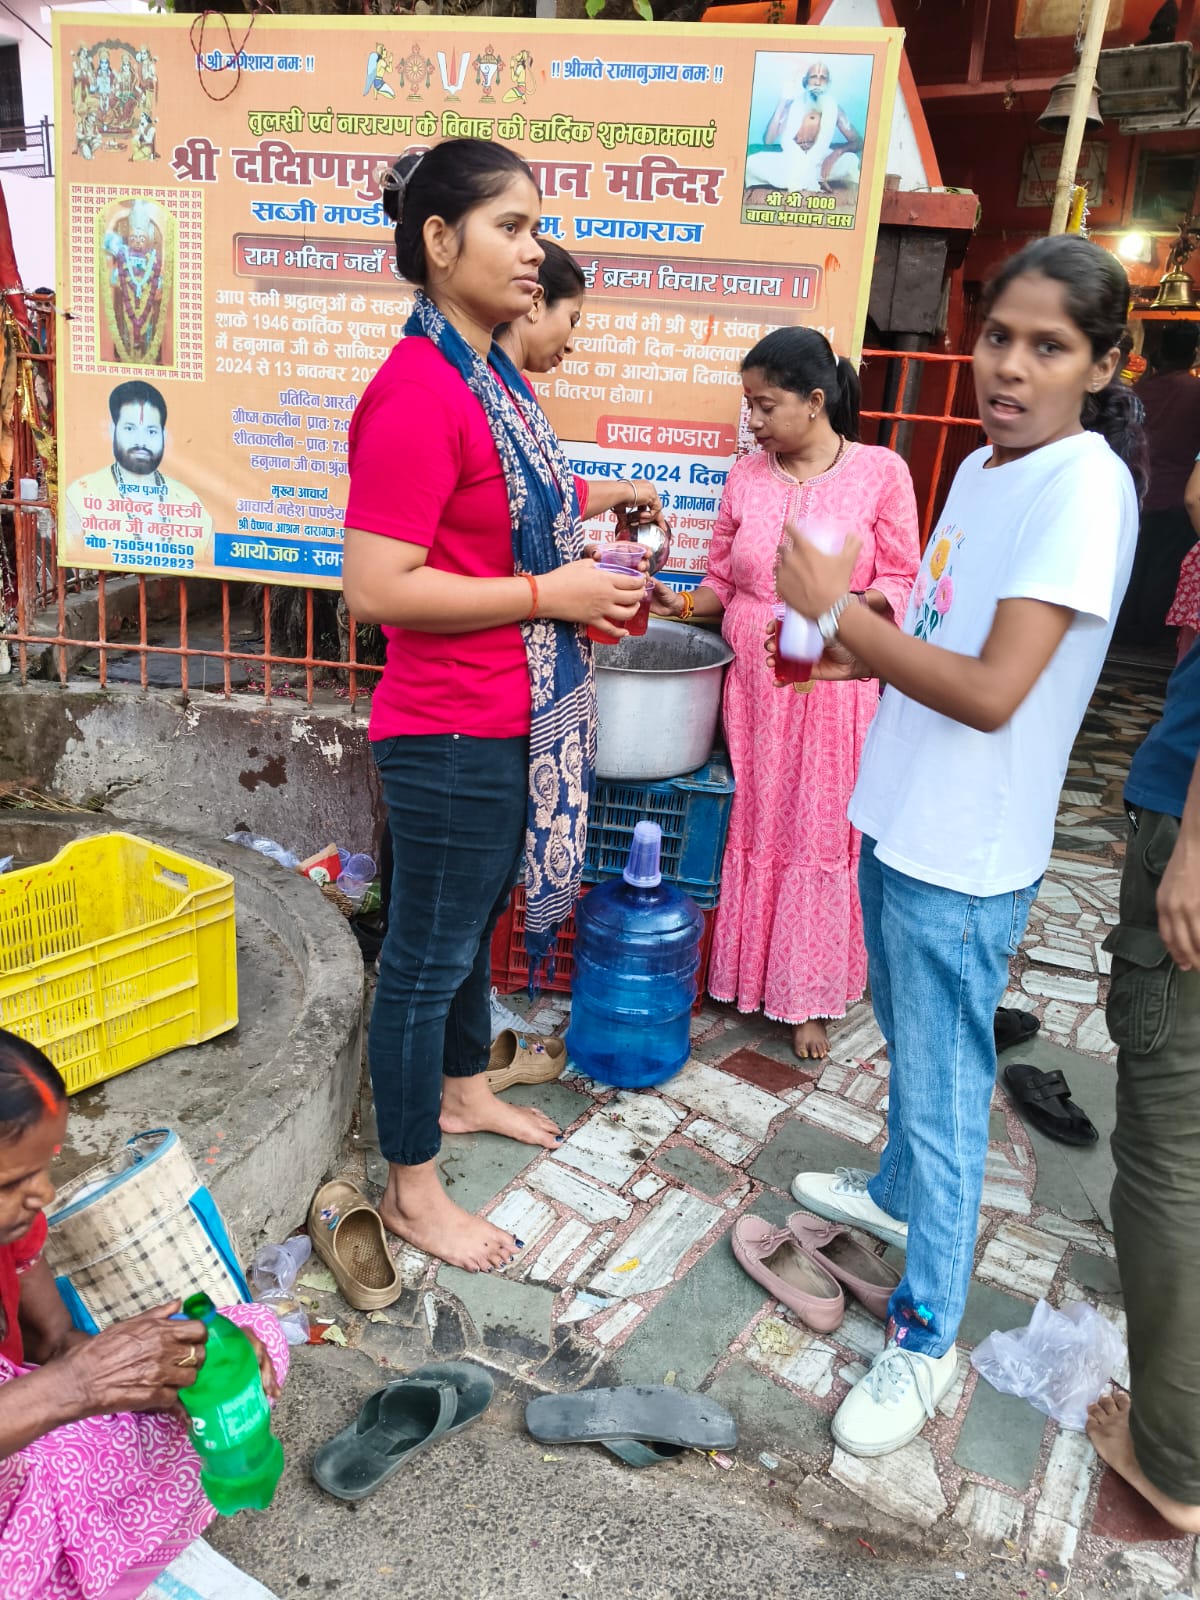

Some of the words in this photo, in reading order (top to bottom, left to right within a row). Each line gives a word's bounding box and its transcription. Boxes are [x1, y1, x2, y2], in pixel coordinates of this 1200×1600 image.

[207, 50, 222, 70] श्री
[226, 51, 274, 71] गणेशाय
[277, 56, 302, 70] नमः
[564, 57, 604, 79] श्रीमते
[606, 62, 679, 84] रामानुजाय
[682, 65, 710, 81] नमः
[248, 106, 304, 136] तुलसी
[307, 107, 334, 133] एवं
[336, 114, 413, 136] नारायण
[416, 111, 438, 137] के
[442, 111, 495, 139] विवाह
[497, 113, 527, 140] की
[529, 114, 594, 143] हार्दिक
[597, 119, 717, 149] शुभकामनाएं
[172, 138, 221, 182] श्री
[605, 155, 725, 205] मन्दिर
[766, 191, 783, 207] श्री
[786, 192, 803, 208] श्री
[806, 196, 836, 211] 1008
[251, 198, 318, 223] सब्जी
[574, 217, 705, 243] प्रयागराज
[746, 209, 776, 223] बाबा
[778, 211, 824, 226] भगवान
[827, 213, 854, 228] दास
[244, 247, 280, 267] राम
[284, 245, 339, 271] भक्ति
[343, 247, 386, 274] जहाँ
[657, 265, 719, 293] विचार
[722, 274, 784, 297] प्रचारा
[215, 288, 245, 306] आप
[248, 288, 281, 309] सभी
[350, 294, 367, 313] के
[586, 312, 611, 331] इस
[614, 311, 638, 331] वर्ष
[641, 312, 663, 333] भी
[665, 313, 686, 335] श्री
[253, 313, 289, 332] 1946
[292, 315, 343, 335] कार्तिक
[347, 320, 388, 341] शुक्ल
[232, 336, 285, 357] हनुमान
[290, 334, 309, 357] जी
[313, 338, 330, 358] के
[562, 359, 590, 377] पाठ
[594, 362, 617, 379] का
[621, 361, 689, 384] आयोजन
[215, 356, 252, 374] 2024
[256, 357, 272, 377] से
[275, 362, 293, 378] 13
[296, 364, 348, 383] नवम्बर
[555, 378, 605, 401] वितरण
[279, 389, 321, 408] प्रतिदिन
[232, 408, 259, 425] ग्रीष्म
[262, 411, 301, 428] कालीन
[307, 415, 330, 430] प्रातः
[233, 430, 295, 449] शीतकालीन
[306, 437, 329, 452] प्रातः
[607, 423, 653, 444] प्रसाद
[656, 426, 720, 449] भण्डारा
[251, 455, 290, 471] हनुमान
[294, 457, 308, 472] जी
[311, 461, 326, 473] का
[631, 462, 681, 483] 2024
[118, 483, 140, 494] मुख्य
[272, 485, 295, 499] मुख्य
[298, 487, 328, 500] आचार्य
[157, 502, 202, 519] शास्त्री
[237, 499, 274, 514] आचार्य
[277, 501, 305, 517] महेश
[673, 495, 716, 513] आगमन
[82, 514, 121, 531] गौतम
[125, 517, 144, 535] जी
[147, 521, 203, 539] महाराज
[238, 516, 249, 530] श्री
[275, 522, 300, 535] आश्रम
[668, 513, 678, 529] से
[588, 530, 602, 542] या
[678, 532, 700, 550] लिए
[112, 552, 195, 570] 7355202823
[230, 540, 300, 563] आयोजक
